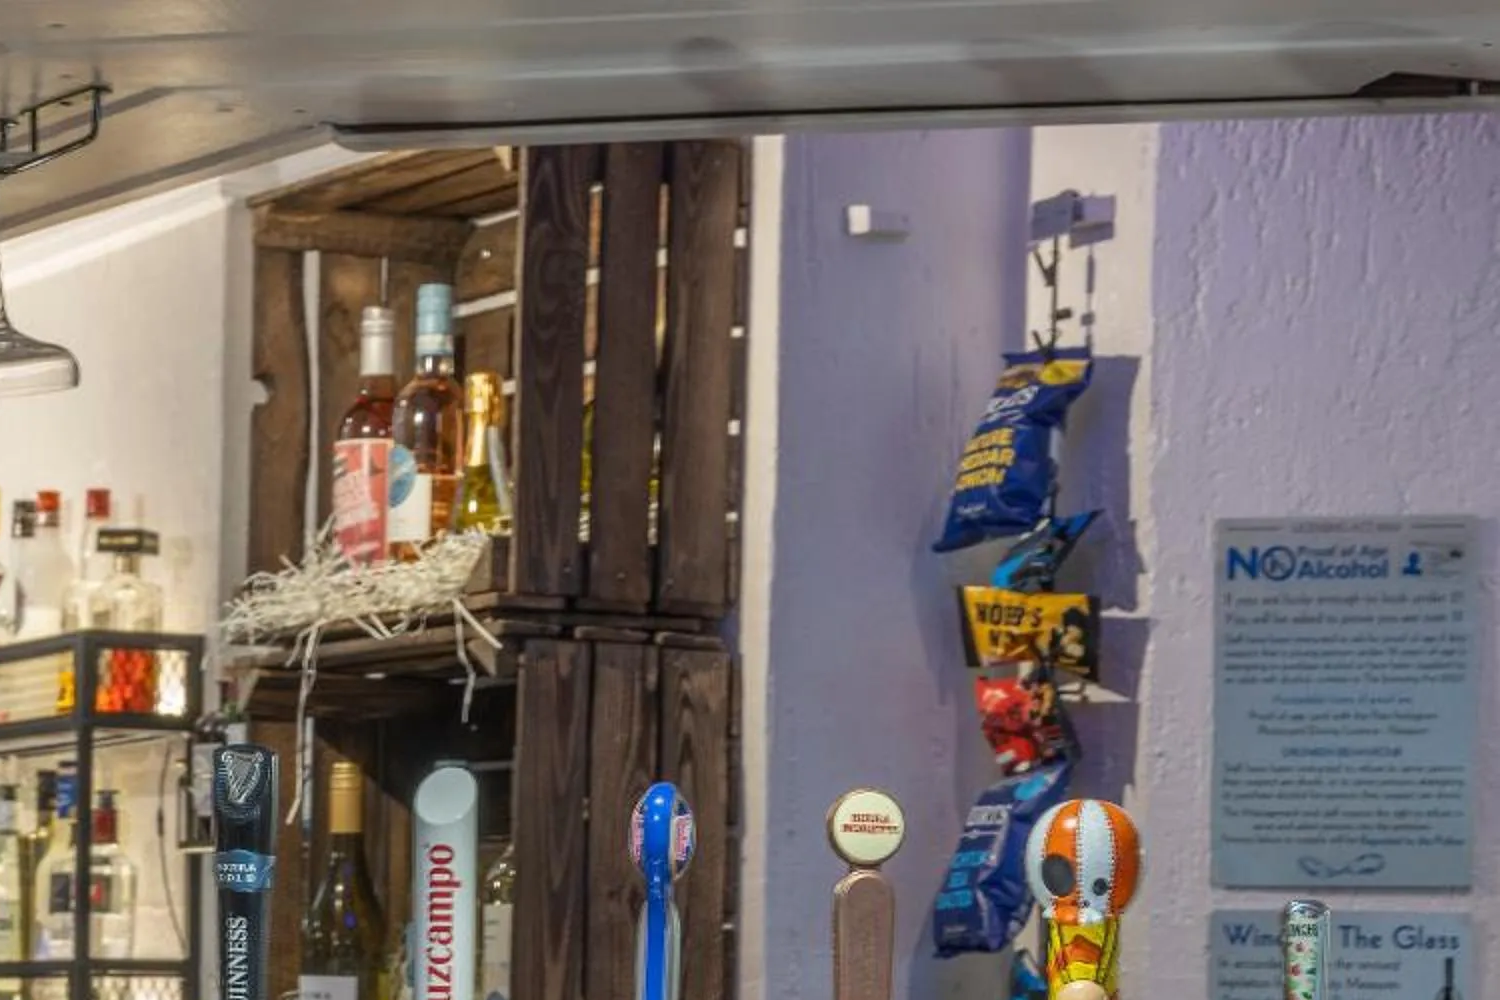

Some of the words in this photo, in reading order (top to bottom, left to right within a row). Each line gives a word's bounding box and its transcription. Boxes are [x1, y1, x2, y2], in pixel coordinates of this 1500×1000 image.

[1298, 559, 1389, 580] Alcohol
[1338, 924, 1382, 949] The
[1393, 924, 1460, 949] Glass
